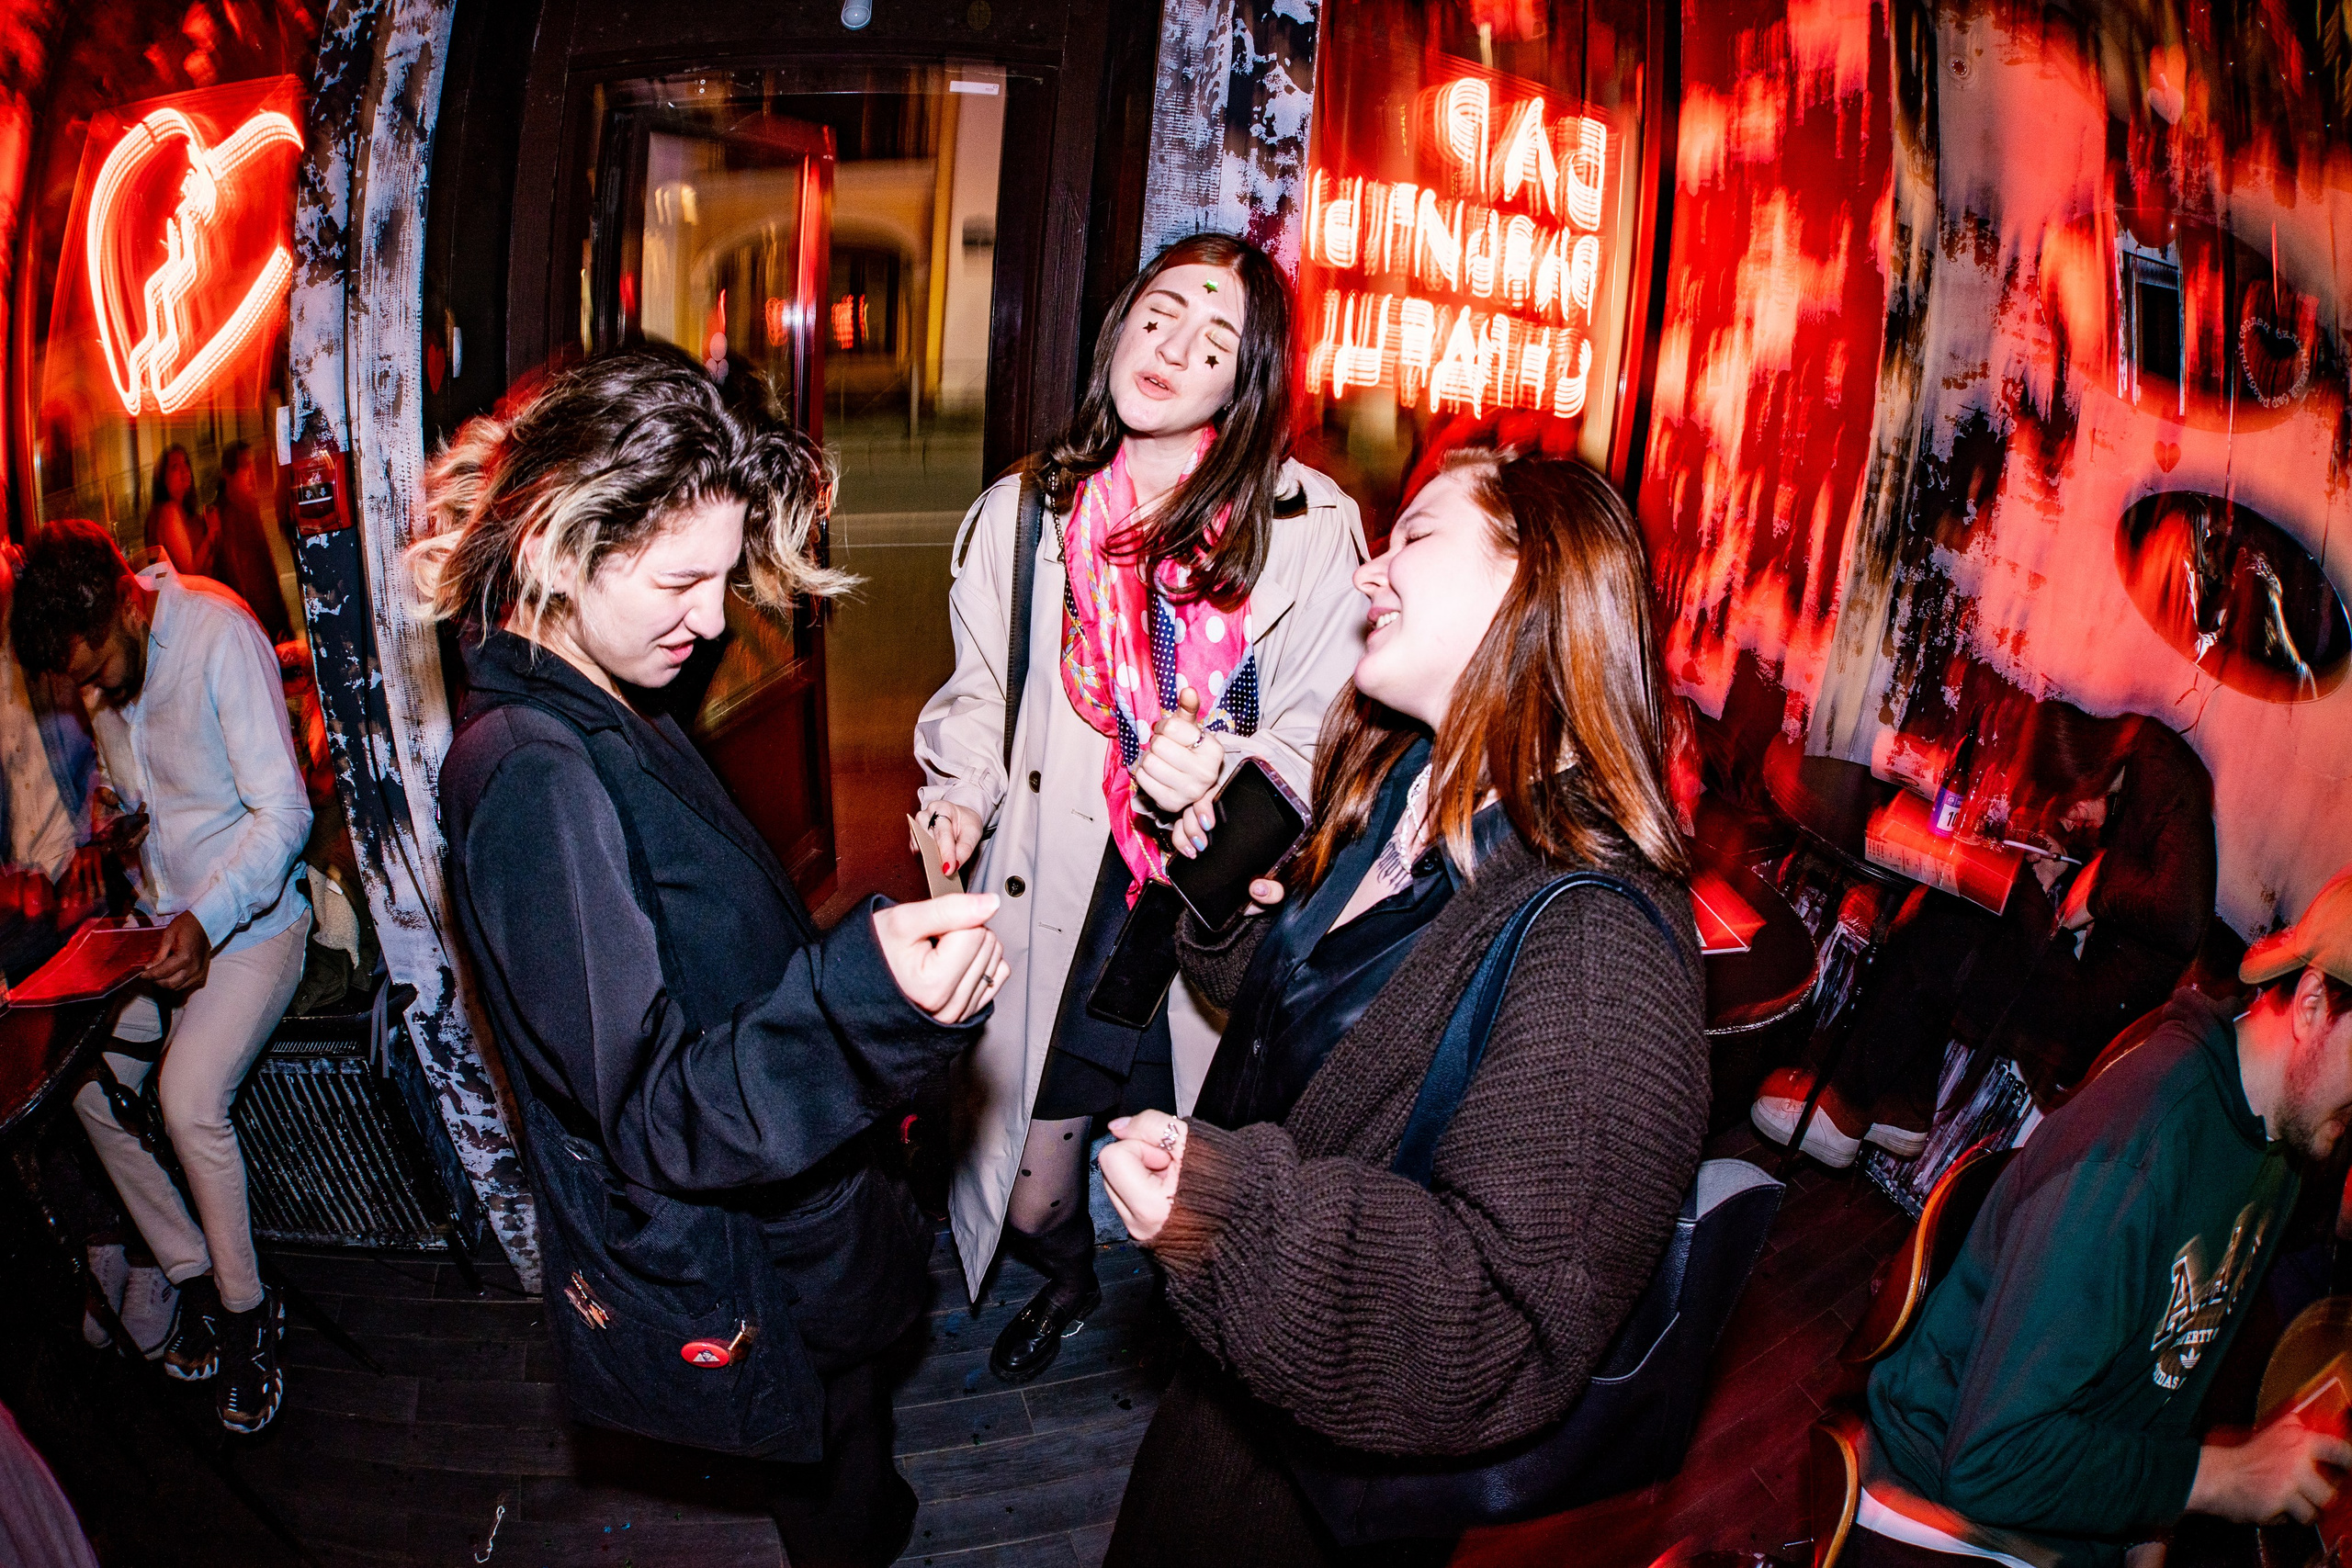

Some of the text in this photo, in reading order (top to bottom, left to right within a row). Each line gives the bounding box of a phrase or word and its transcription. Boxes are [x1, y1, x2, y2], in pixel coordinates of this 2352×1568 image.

[2238, 316, 2270, 339] сердец
[2238, 342, 2270, 409] разбитых
[2271, 392, 2290, 409] бар
